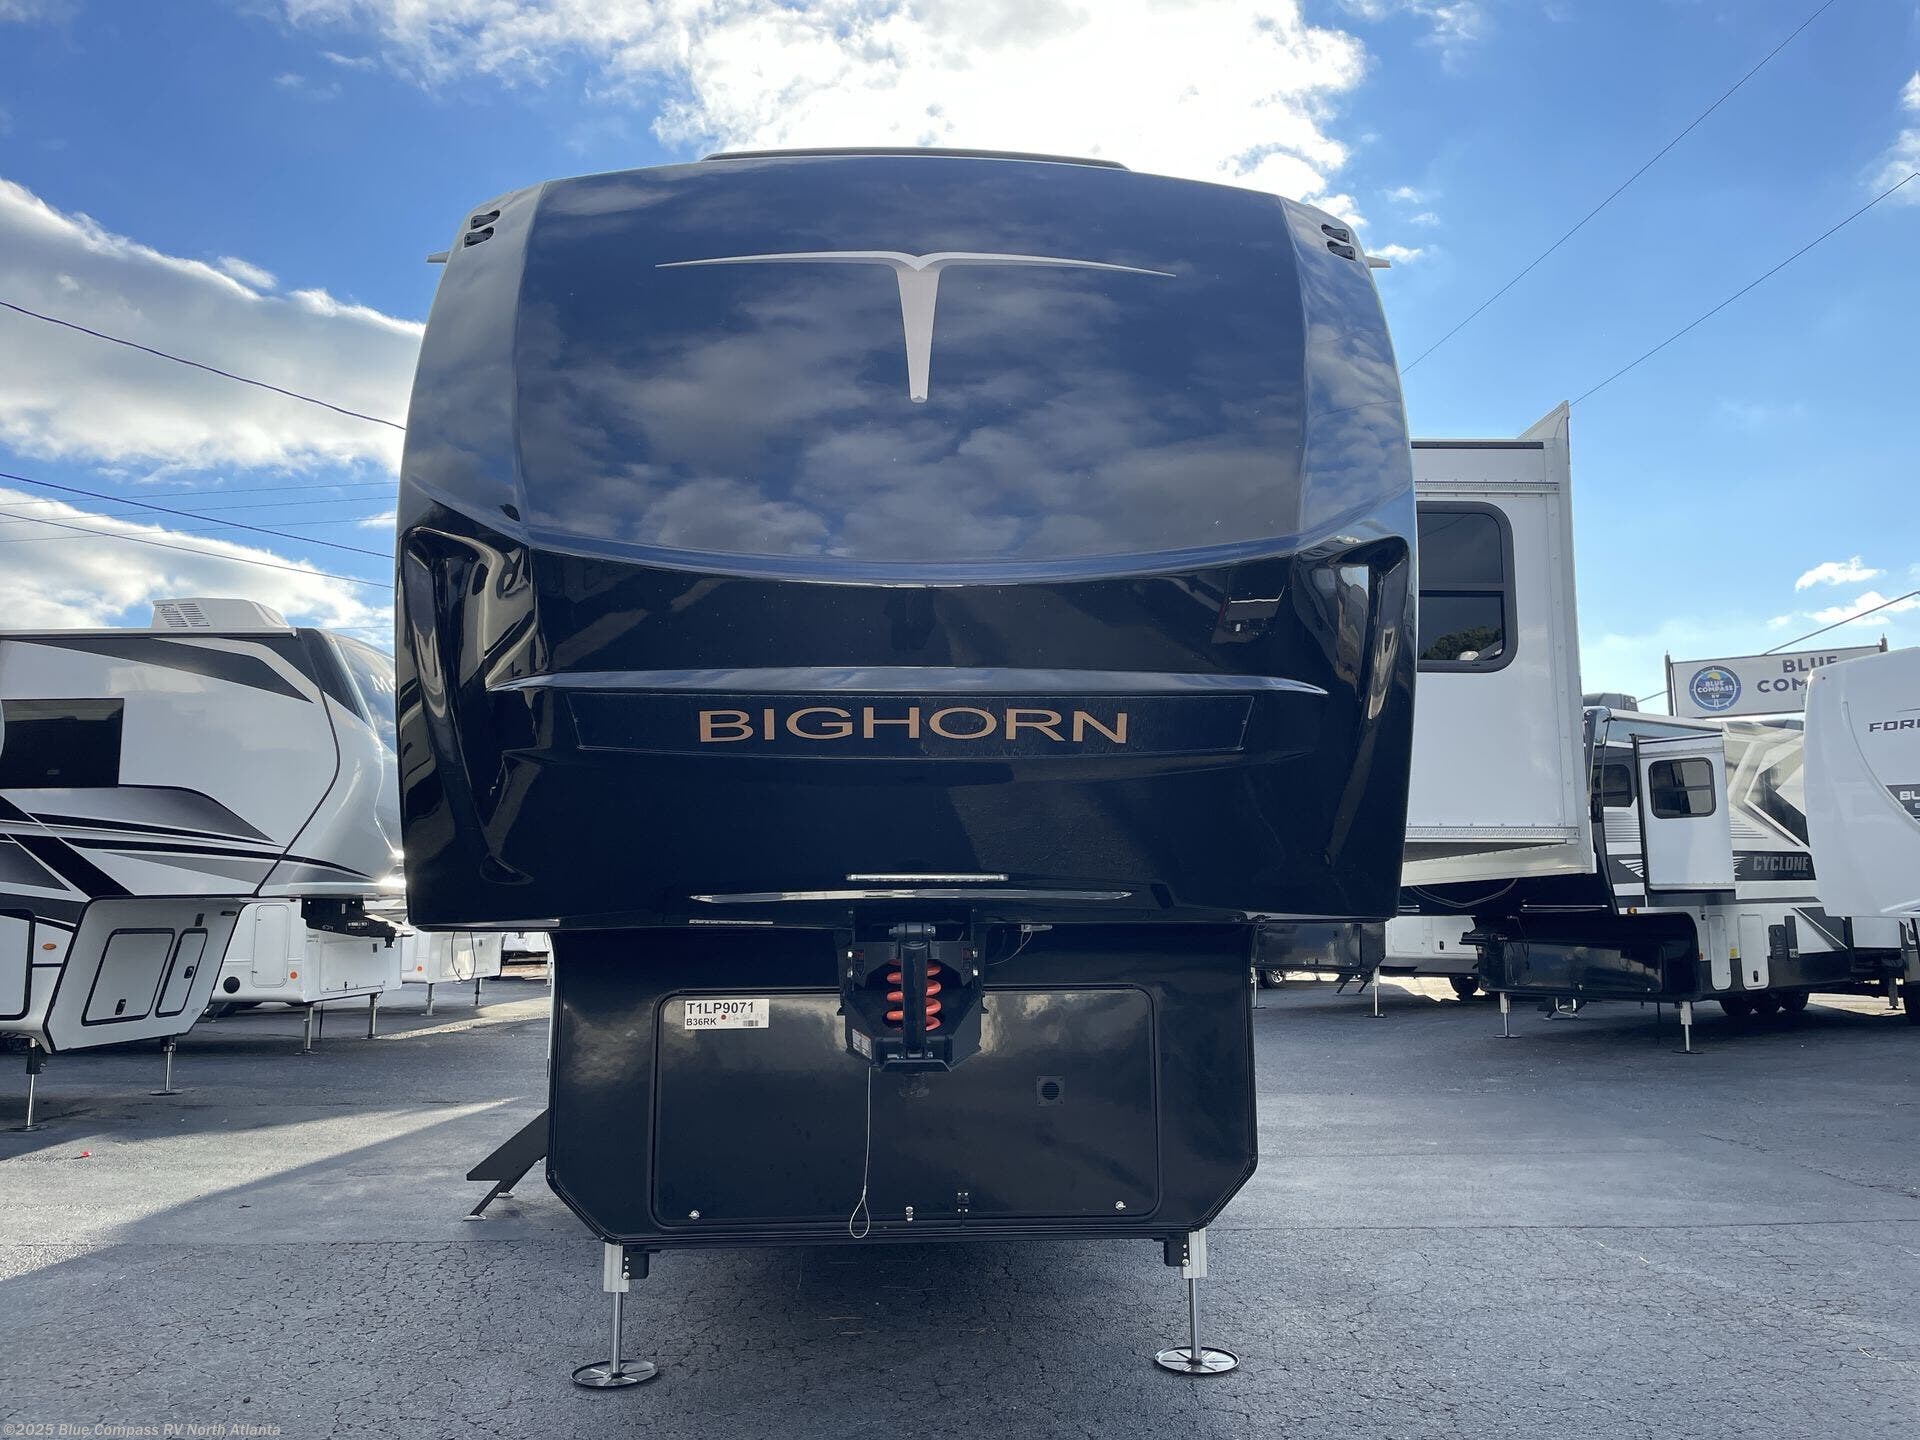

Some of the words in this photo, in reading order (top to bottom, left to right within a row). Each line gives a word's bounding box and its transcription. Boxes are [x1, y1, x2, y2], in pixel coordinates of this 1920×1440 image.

[699, 707, 1128, 744] BIGHORN
[1753, 856, 1808, 871] CYCLONE
[687, 1002, 754, 1014] T1LP9071
[686, 1018, 717, 1026] B36RK
